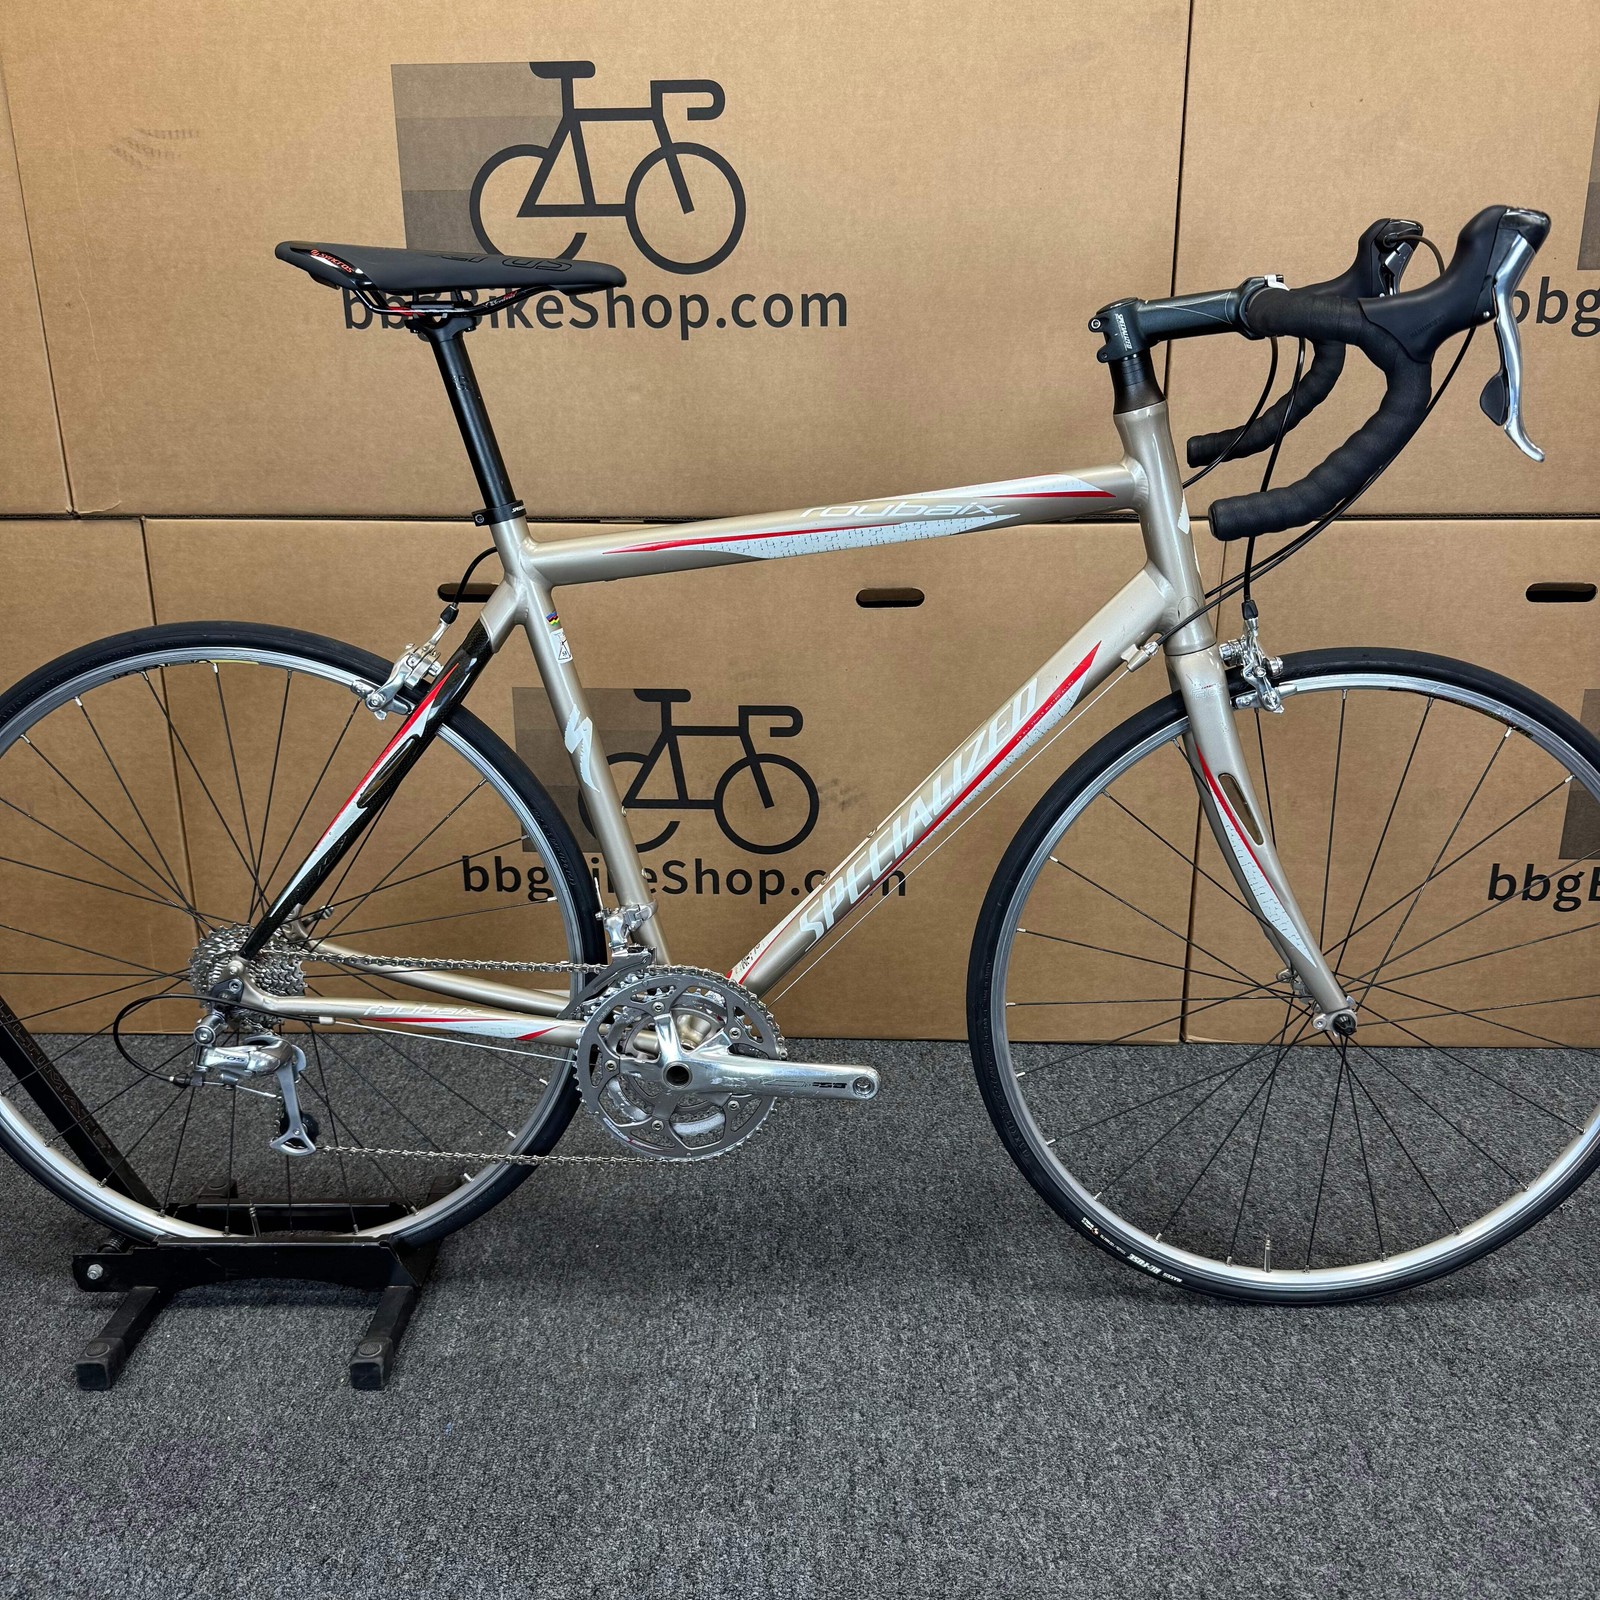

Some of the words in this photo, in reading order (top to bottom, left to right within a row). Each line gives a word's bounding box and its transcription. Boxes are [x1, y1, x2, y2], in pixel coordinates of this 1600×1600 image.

[342, 286, 848, 341] bbikeShop.com
[799, 501, 1005, 518] roubaix
[799, 677, 1038, 951] SPECIALIZED
[462, 855, 907, 904] bbgiShop.cm
[363, 1004, 482, 1016] roubaix
